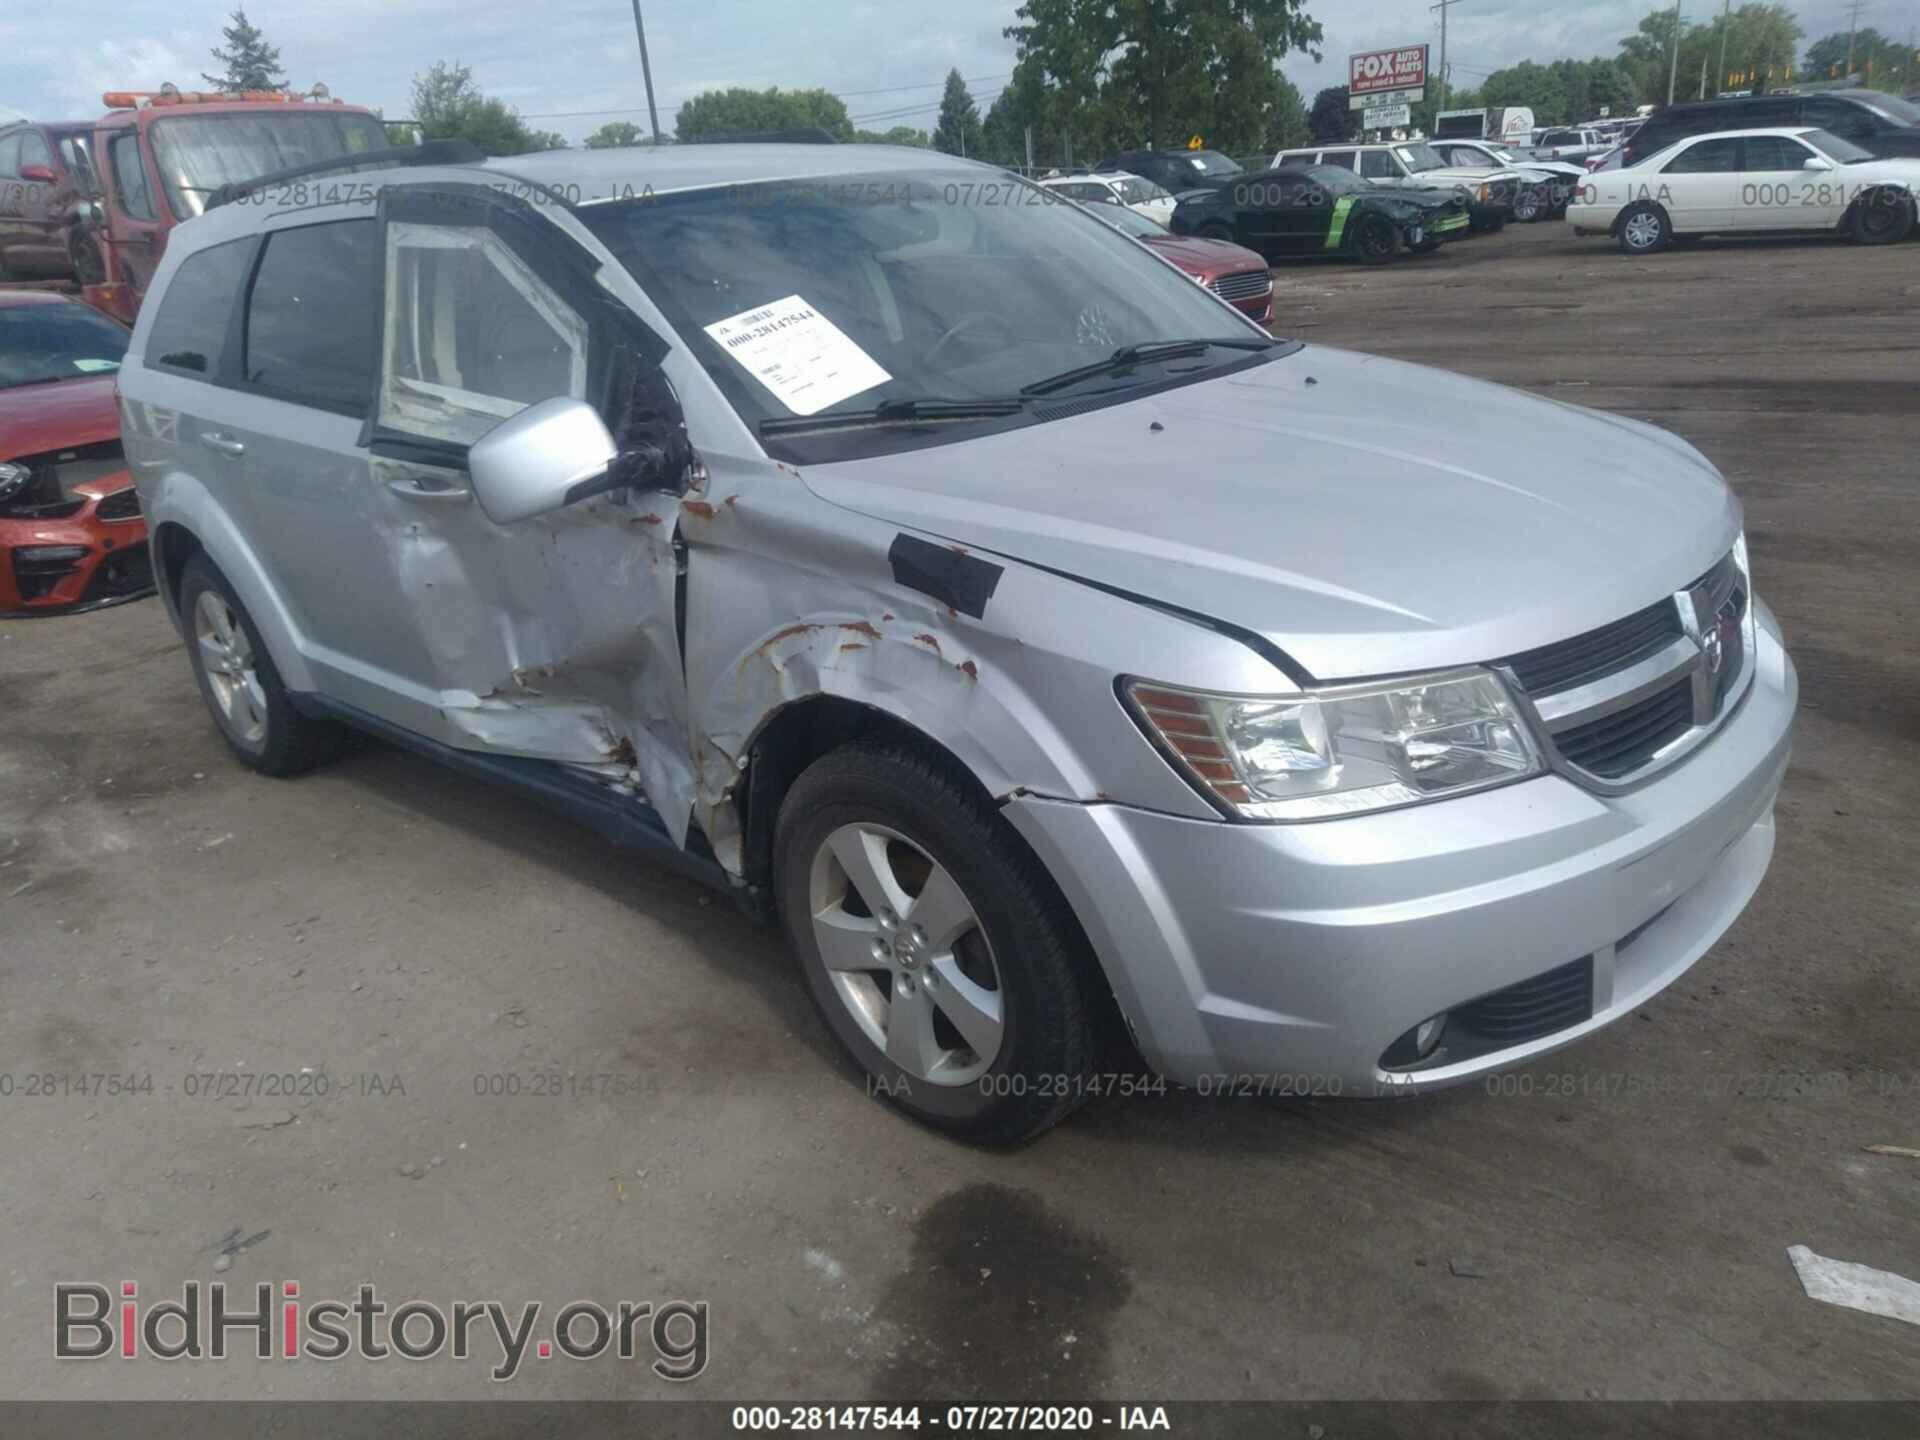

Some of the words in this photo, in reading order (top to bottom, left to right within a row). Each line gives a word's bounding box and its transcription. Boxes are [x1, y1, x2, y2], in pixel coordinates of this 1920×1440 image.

[1395, 50, 1420, 62] AUTO
[1353, 53, 1394, 80] FOX
[1395, 60, 1422, 74] PARTS
[726, 309, 815, 349] 000-28147544
